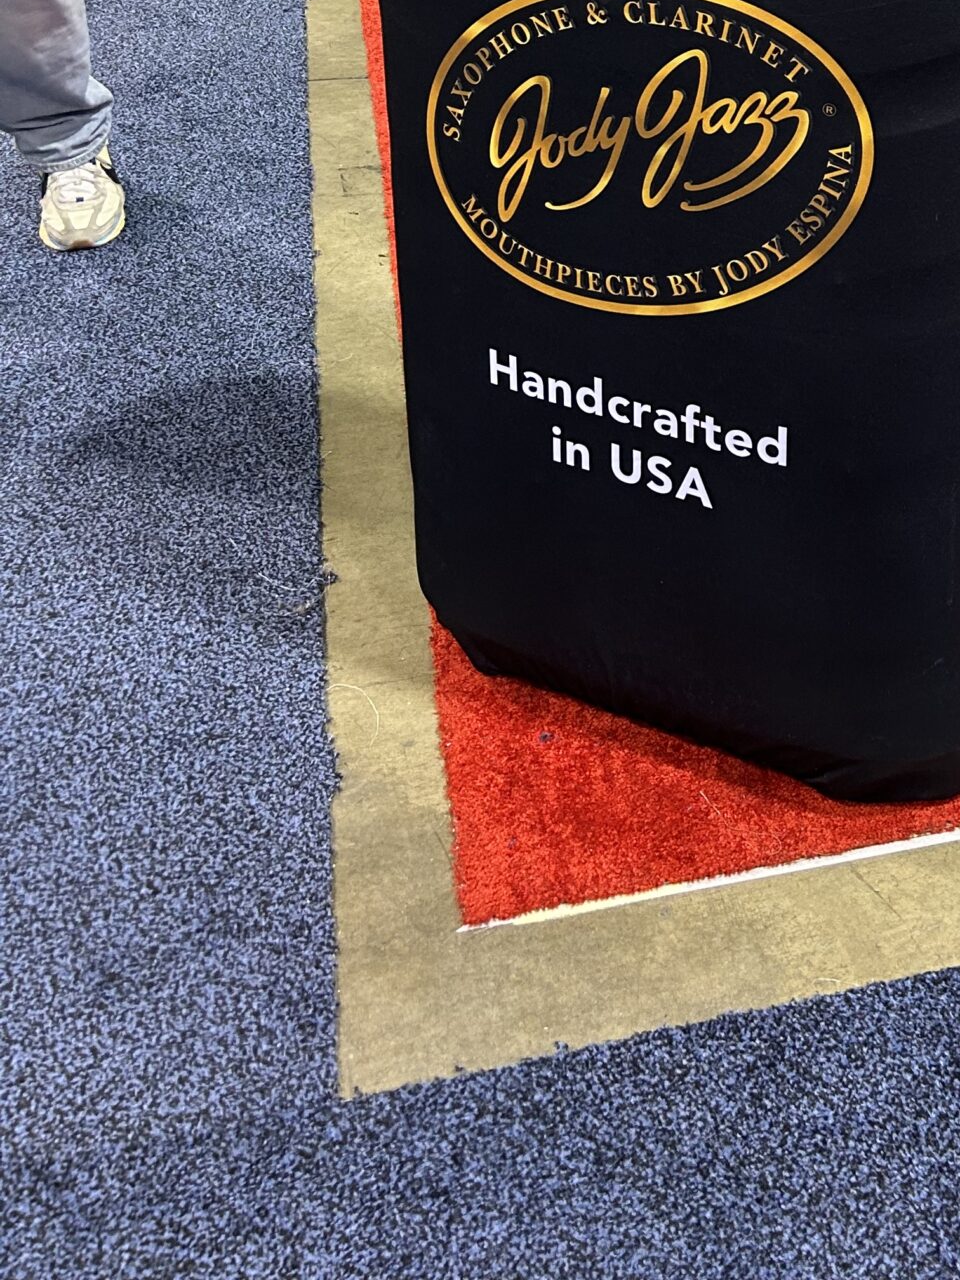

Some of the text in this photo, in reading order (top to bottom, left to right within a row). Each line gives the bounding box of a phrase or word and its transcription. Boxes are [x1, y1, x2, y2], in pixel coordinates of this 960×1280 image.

[442, 0, 811, 141] SAXOPHONE & CLARINET
[461, 143, 854, 299] MOUTHPIECES BY JODY ESPINA
[488, 347, 789, 468] Handcrafted
[551, 426, 714, 510] in USA
